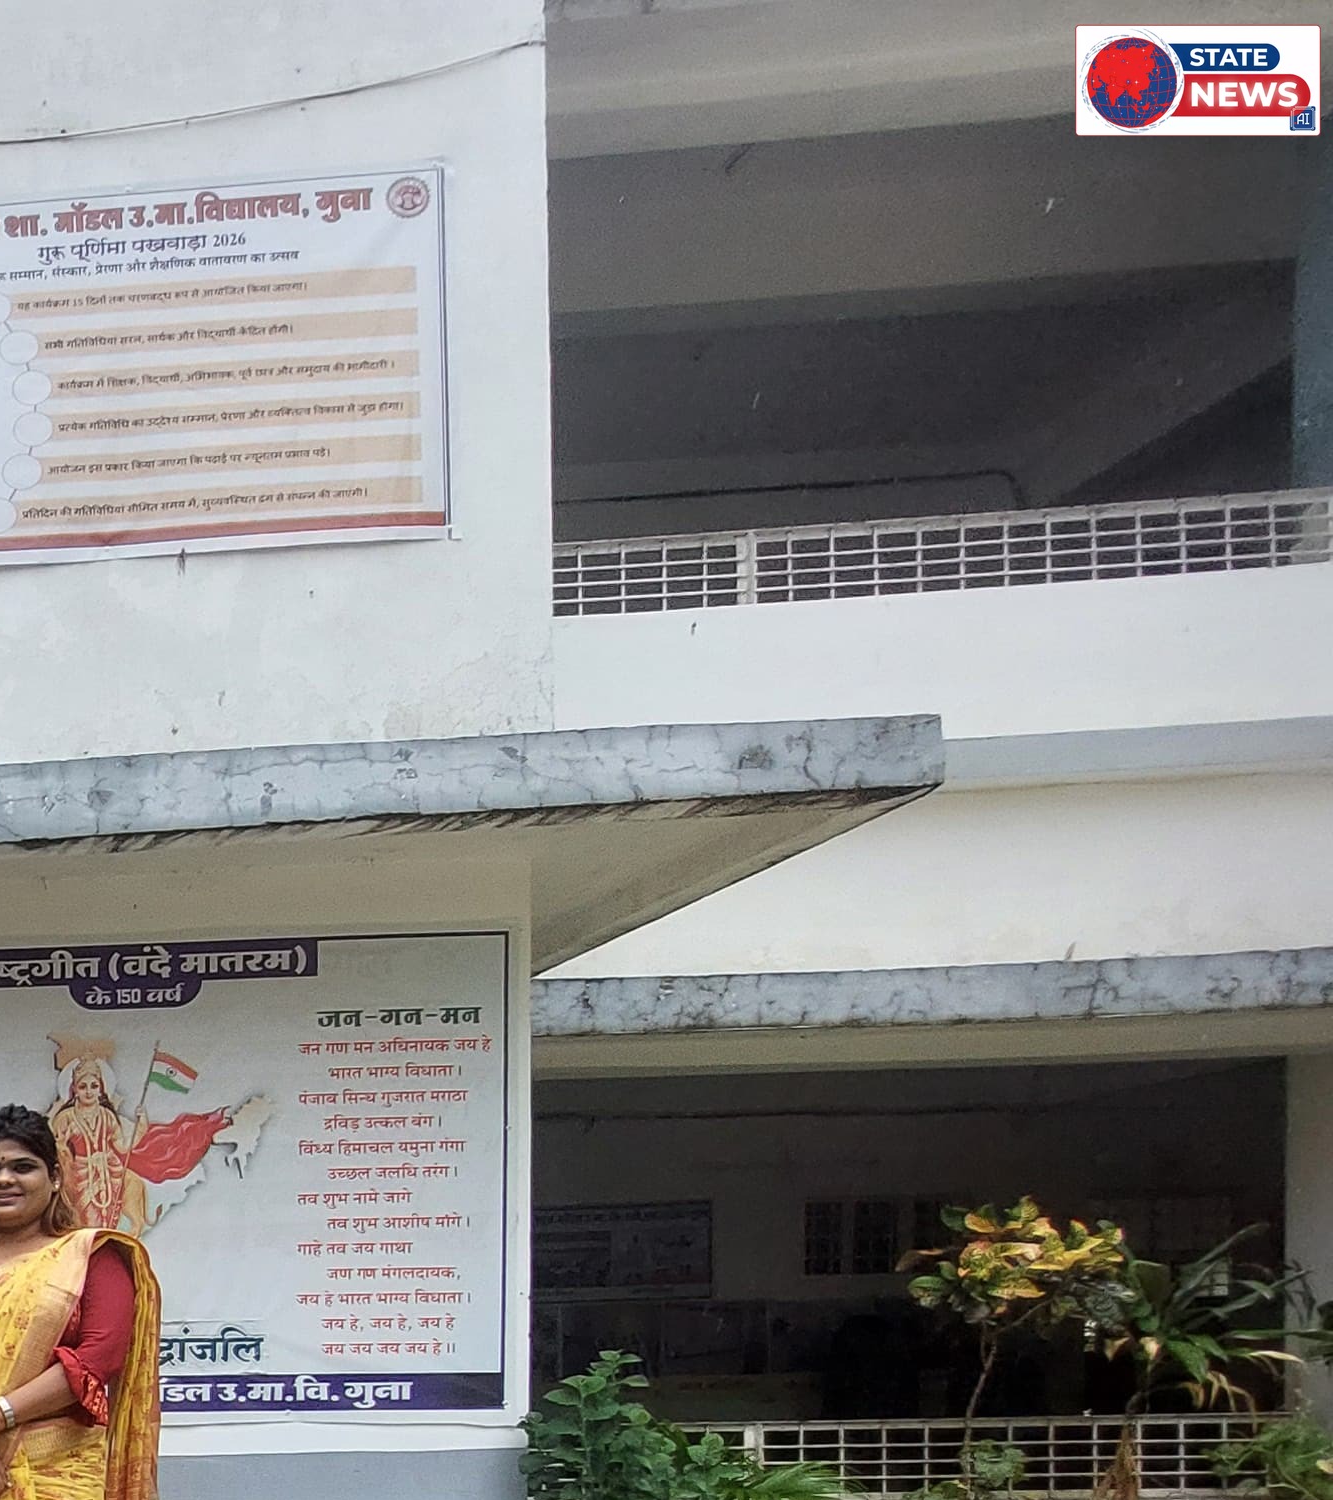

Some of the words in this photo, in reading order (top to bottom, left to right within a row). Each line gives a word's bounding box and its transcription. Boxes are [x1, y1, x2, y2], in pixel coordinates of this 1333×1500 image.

[71, 239, 126, 262] पूर्णिमा
[132, 234, 207, 254] पखवाड़ा
[213, 233, 246, 247] 2026
[126, 259, 147, 272] और
[251, 253, 265, 263] का
[109, 945, 171, 978] (वंदे
[181, 944, 308, 975] मातरम)
[86, 986, 111, 1006] के
[117, 988, 141, 1005] 150
[146, 982, 186, 1003] वर्ष
[317, 1006, 482, 1028] जन-गन-मन
[298, 1043, 320, 1055] जन
[326, 1042, 348, 1055] गण
[354, 1041, 374, 1053] मन
[378, 1036, 450, 1053] अधिनायक
[453, 1039, 478, 1051] जय
[482, 1034, 492, 1052] हे
[328, 1067, 363, 1080] भारत
[366, 1067, 399, 1078] भाग्य
[381, 1091, 426, 1108] गुजरात
[431, 1090, 468, 1102] मराठा
[365, 1116, 408, 1129] उत्कल
[338, 1139, 394, 1155] हिमाचल
[399, 1141, 436, 1157] यमुना
[439, 1140, 466, 1153] गंगा
[327, 1167, 372, 1180] उच्छल
[375, 1163, 418, 1179] जलधि
[298, 1193, 317, 1205] तव
[323, 1192, 350, 1209] शुभ
[353, 1188, 379, 1204] नामे
[383, 1187, 413, 1203] जागे
[297, 1239, 323, 1257] गाहे
[326, 1243, 347, 1255] तव
[351, 1242, 375, 1255] जय
[379, 1242, 413, 1254] गाथा
[357, 1268, 377, 1279] गण
[344, 1381, 414, 1409] गुना
